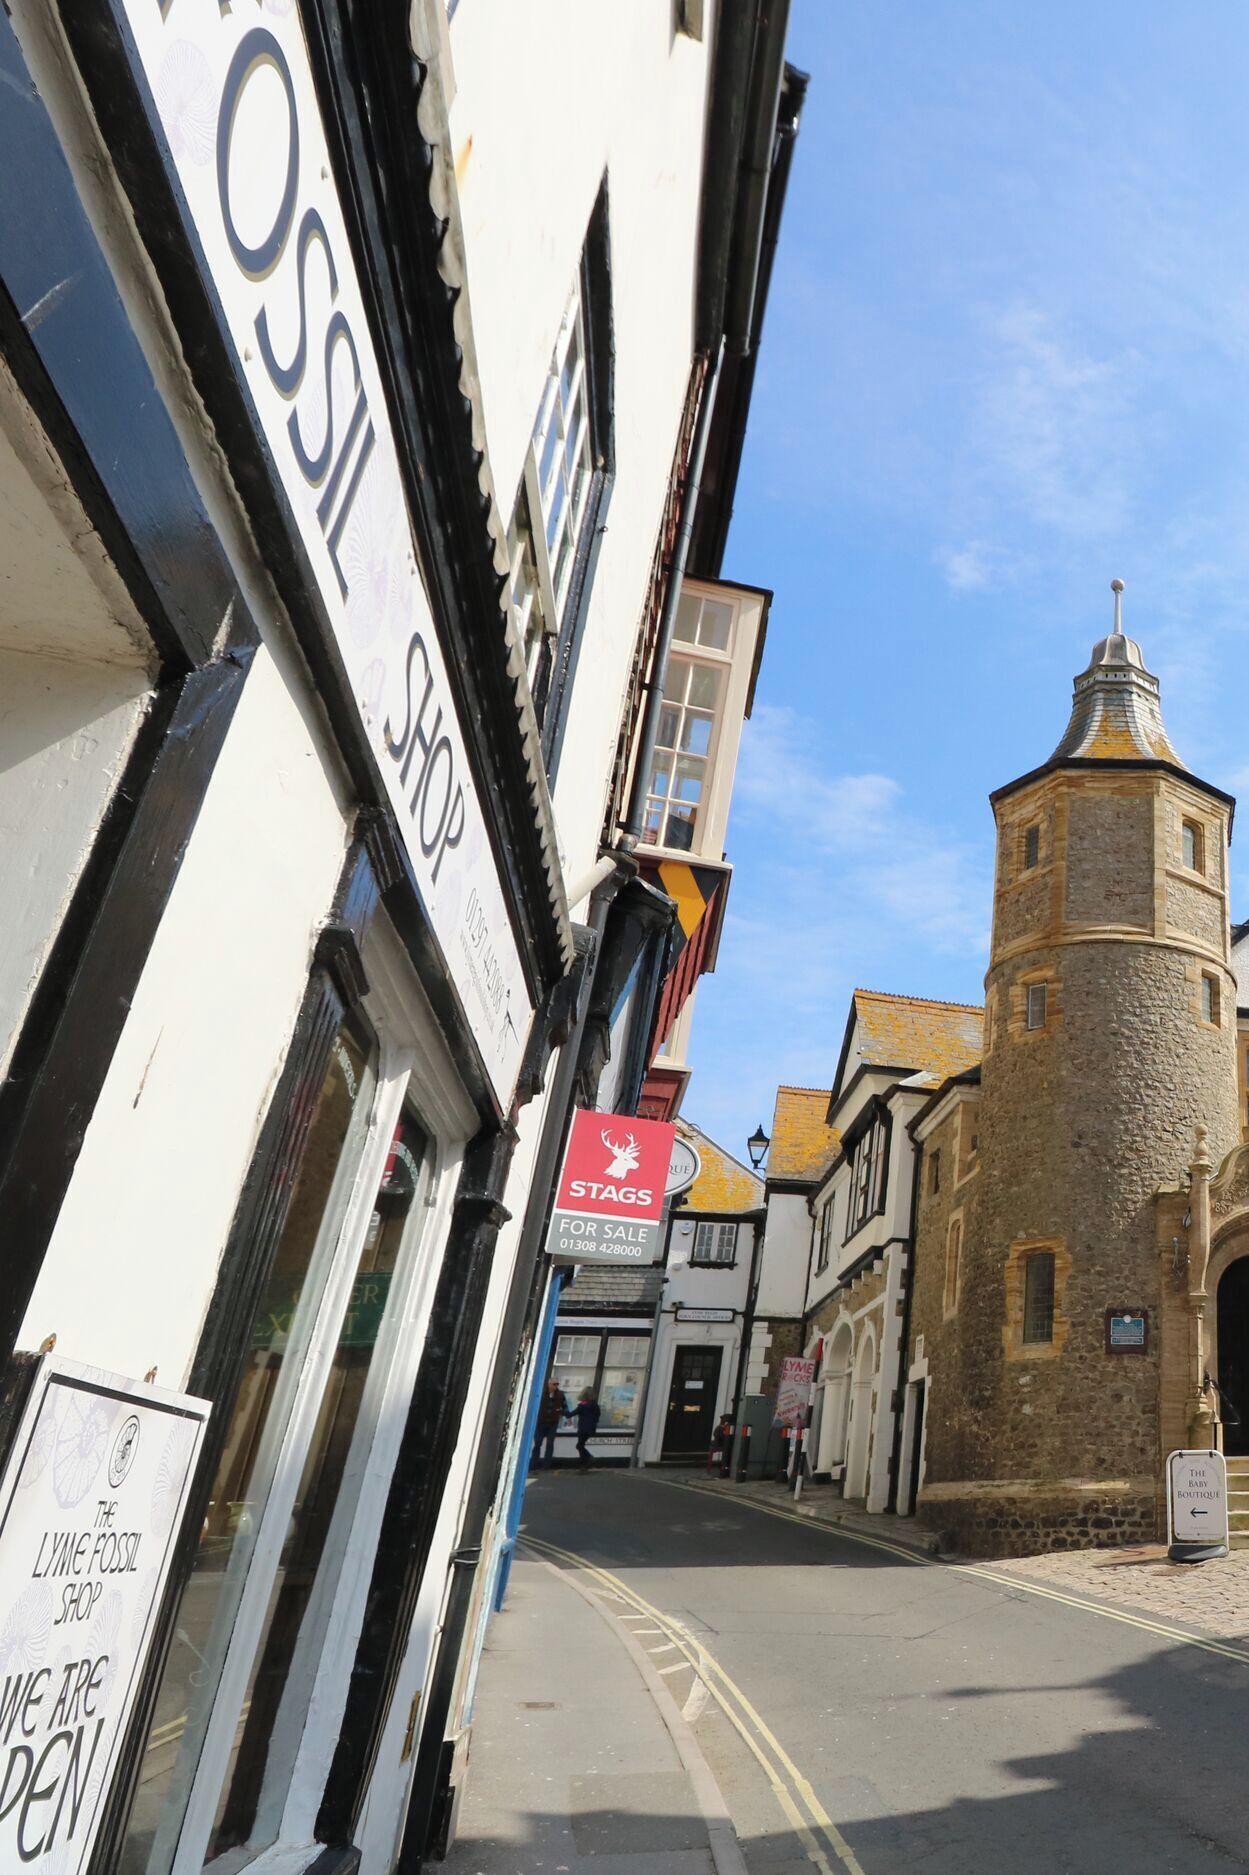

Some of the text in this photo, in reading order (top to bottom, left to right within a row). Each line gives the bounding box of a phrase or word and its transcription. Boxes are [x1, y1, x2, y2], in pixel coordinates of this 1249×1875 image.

[157, 0, 376, 607] OSSIL
[383, 631, 465, 887] SHOP
[465, 888, 489, 957] 01297
[569, 1181, 653, 1206] STAGS
[559, 1219, 648, 1242] FOR SALE
[560, 1238, 642, 1257] 01308 428000
[784, 1360, 815, 1375] LYME
[1188, 1480, 1208, 1488] BABY
[1190, 1469, 1206, 1477] THE
[1177, 1491, 1220, 1500] BOUTIQUE
[94, 1501, 118, 1528] THE
[32, 1532, 142, 1578] LYME FOSSIL
[54, 1581, 103, 1626] SHOP
[0, 1655, 109, 1746] WE ARE
[0, 1717, 105, 1863] PEN
